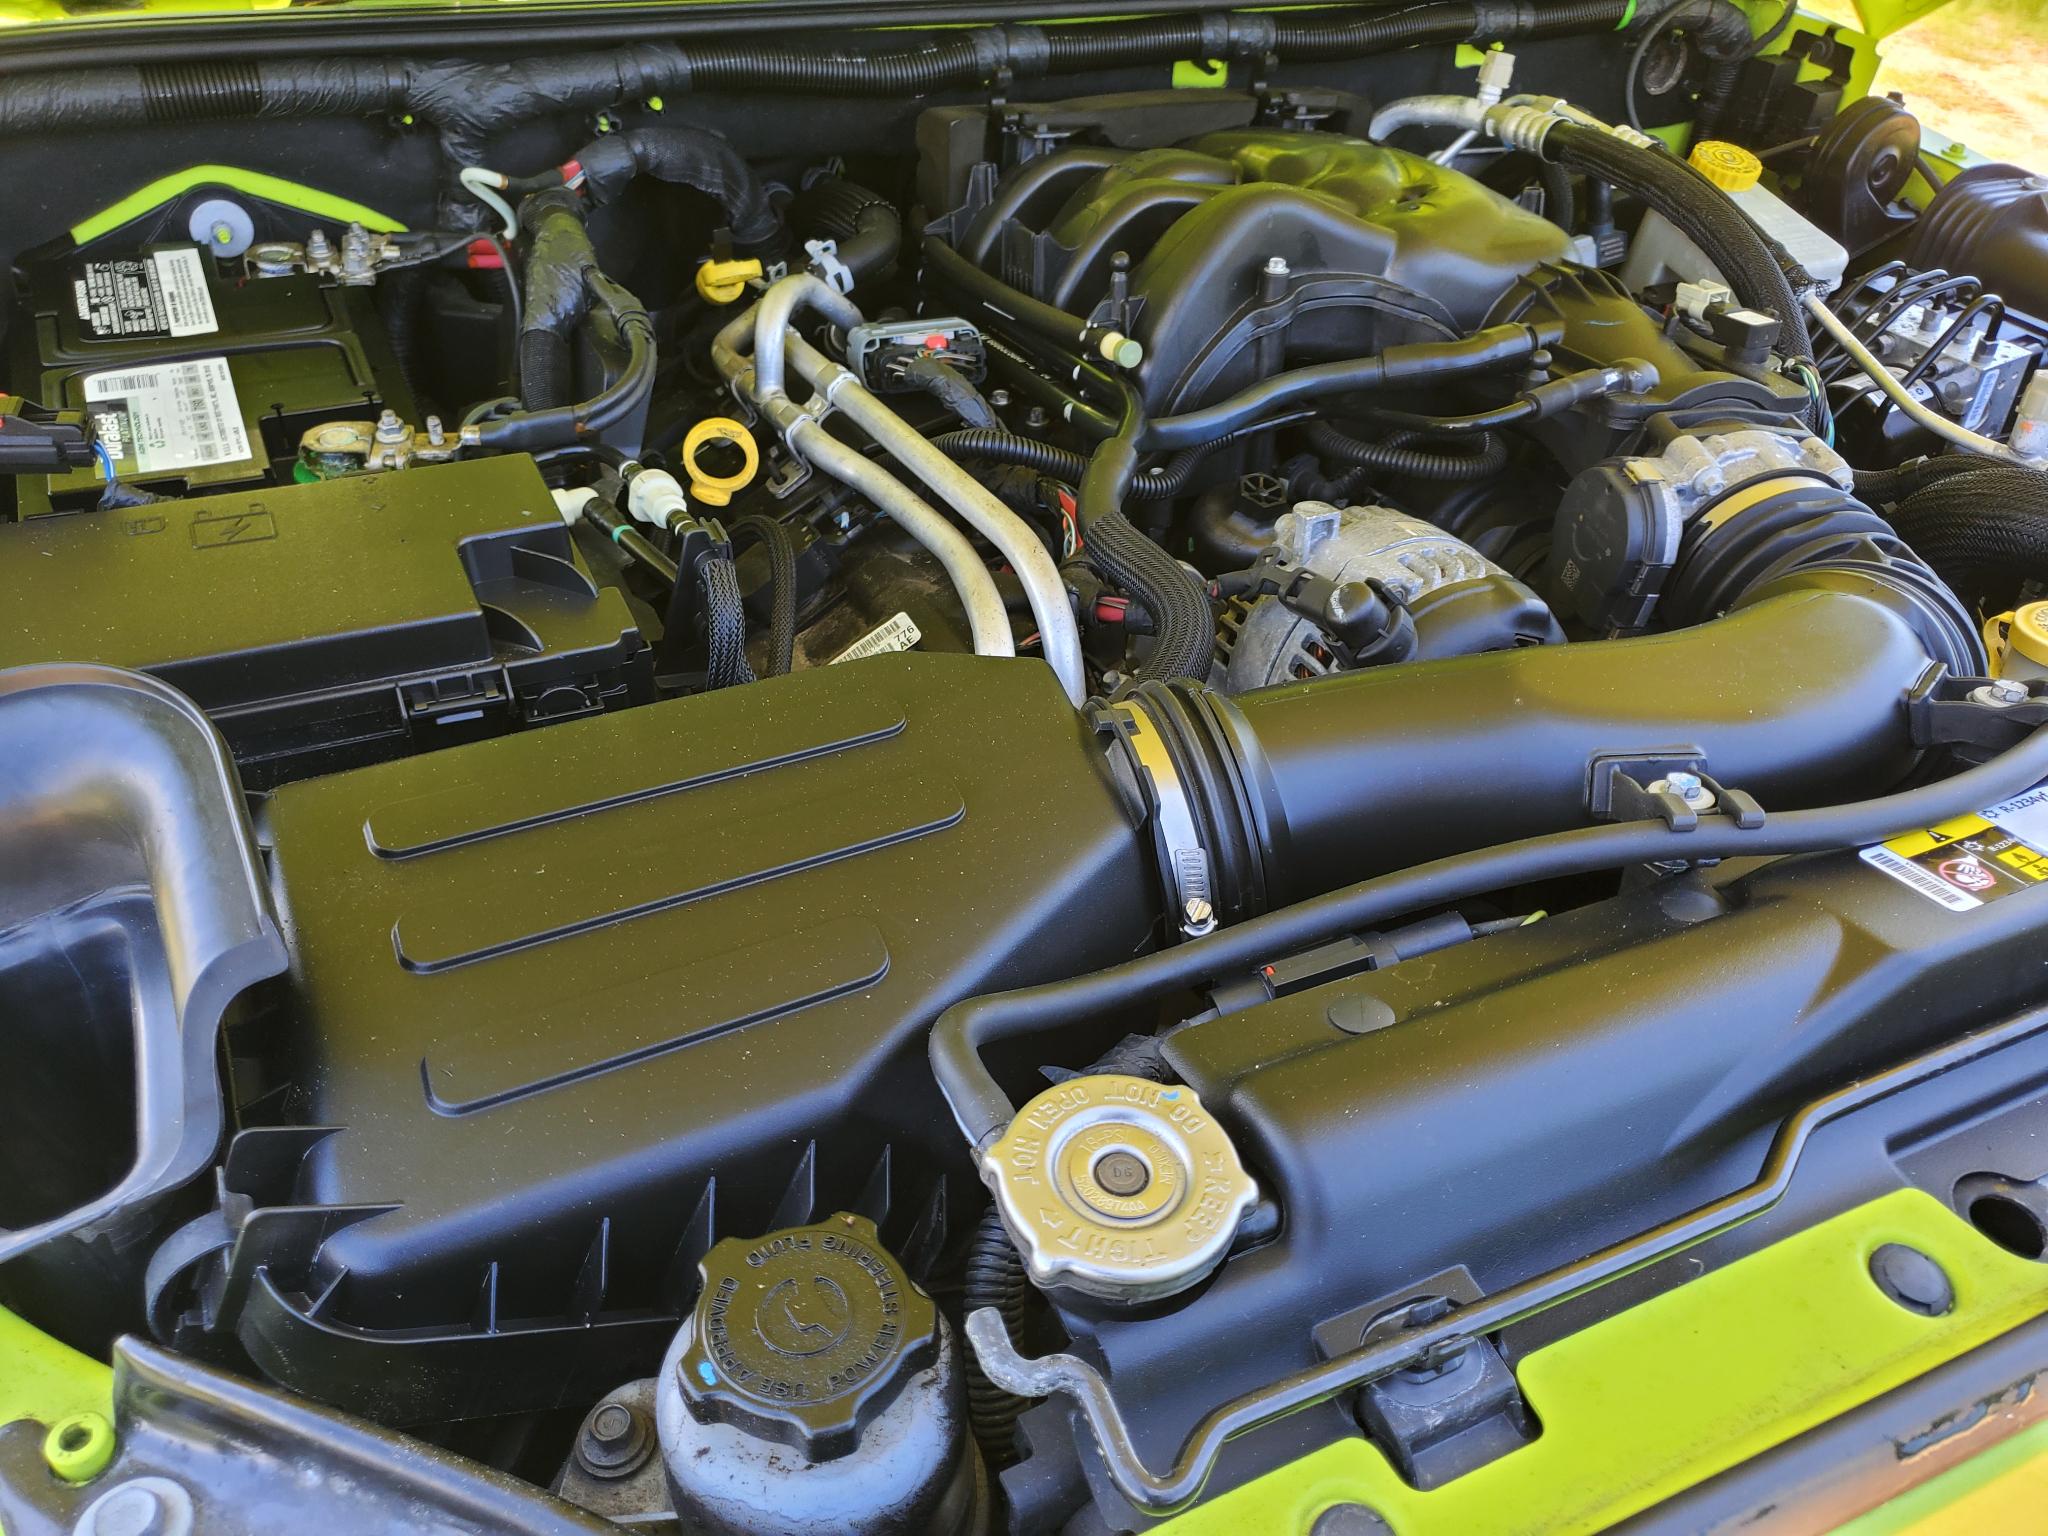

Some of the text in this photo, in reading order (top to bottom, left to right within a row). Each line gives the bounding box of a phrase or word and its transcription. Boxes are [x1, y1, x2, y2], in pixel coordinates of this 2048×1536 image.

[894, 625, 916, 643] 776
[899, 635, 916, 651] AE
[1011, 1083, 1207, 1186] DO NOT OPEN HOT
[1057, 1173, 1231, 1266] KEEP TIGHT
[706, 1235, 900, 1400] USE APPROVED POWER STEERING FLUID
